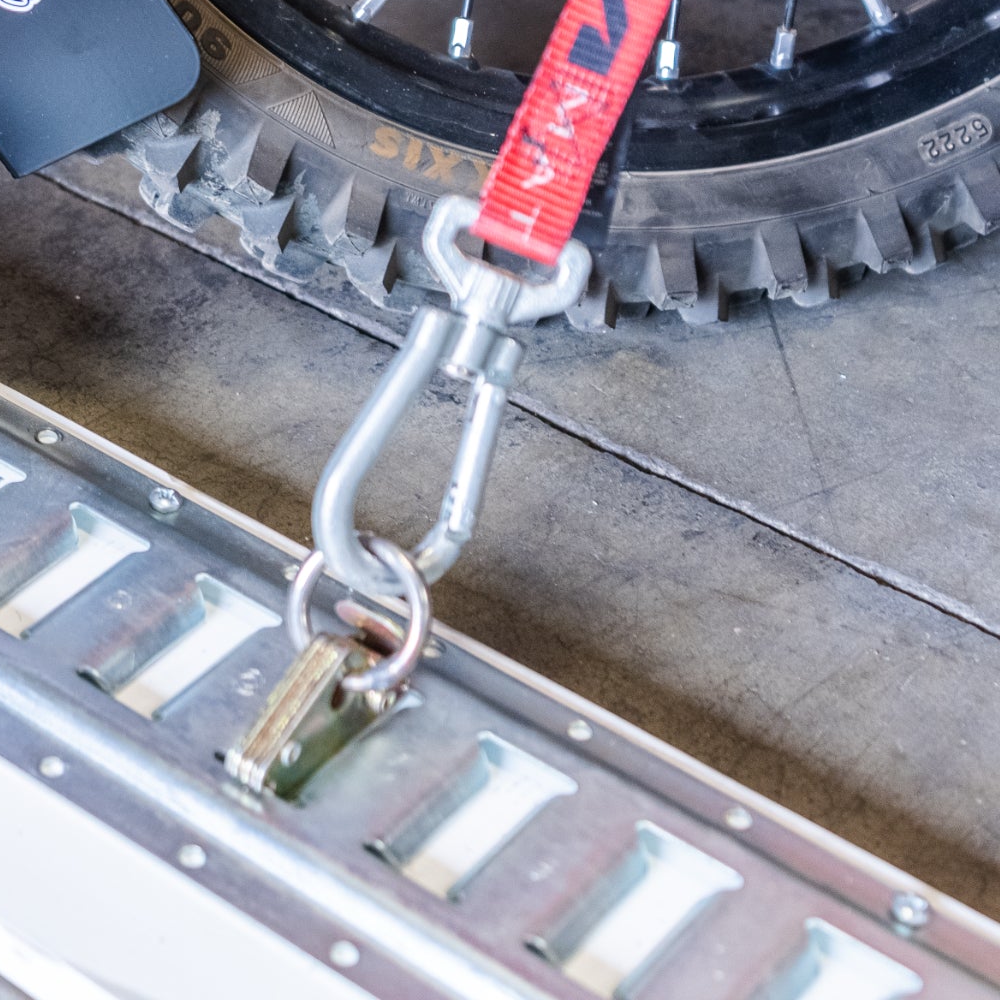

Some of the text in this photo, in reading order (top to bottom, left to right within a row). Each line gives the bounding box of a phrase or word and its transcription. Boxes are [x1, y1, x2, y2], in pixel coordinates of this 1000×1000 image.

[368, 126, 492, 192] XXIS
[509, 78, 591, 243] MAT
[921, 119, 989, 159] 5222
